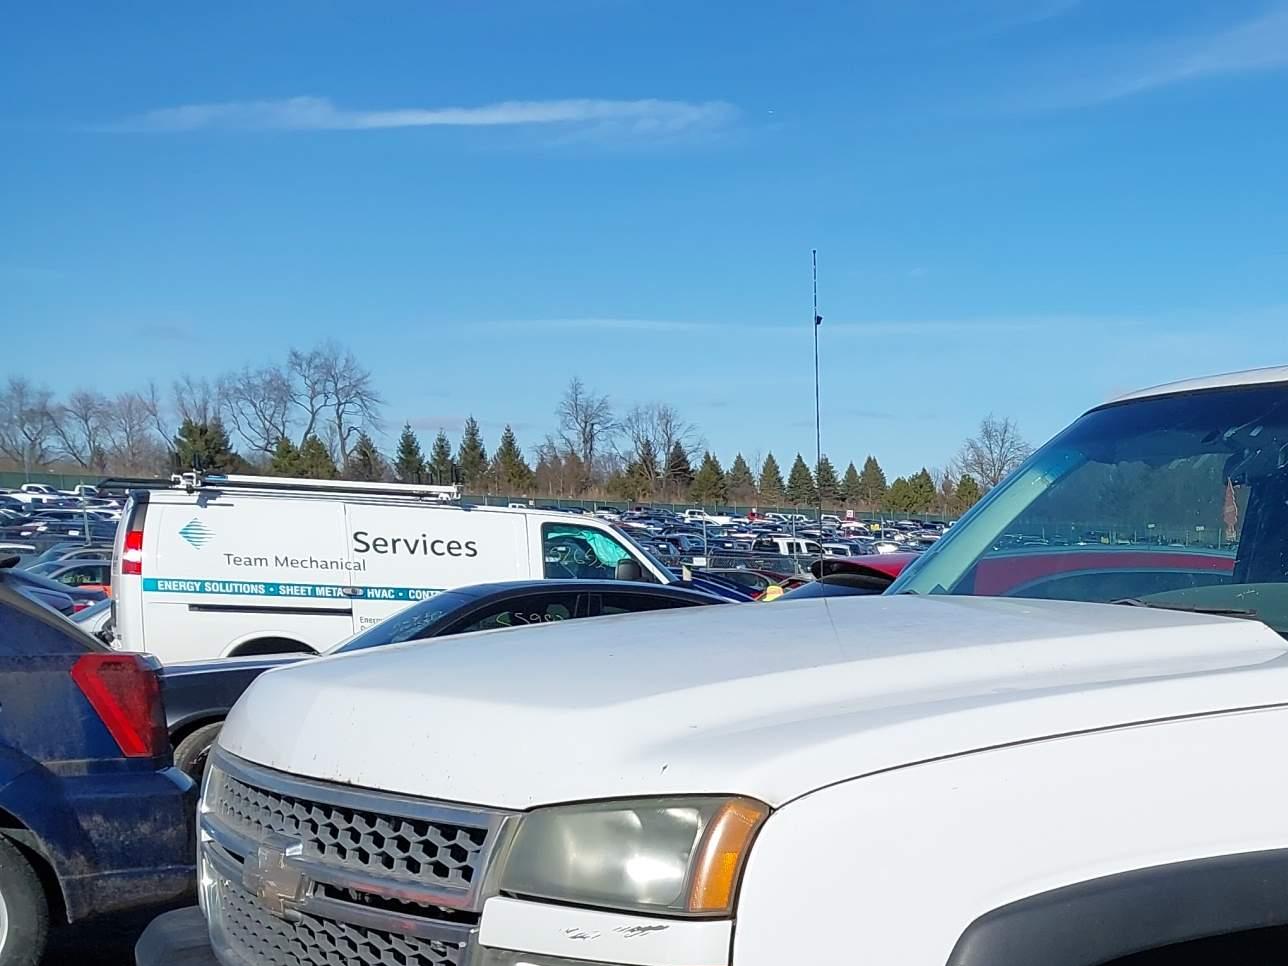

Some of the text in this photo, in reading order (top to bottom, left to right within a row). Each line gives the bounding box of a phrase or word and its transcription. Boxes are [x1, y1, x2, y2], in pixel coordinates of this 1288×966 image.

[352, 531, 478, 557] Services
[223, 553, 367, 571] Team Mechanical
[157, 580, 202, 592] ENERGY
[204, 582, 266, 594] SOLUTIONS
[278, 585, 313, 596] SHEET
[315, 587, 346, 597] META
[366, 588, 396, 599] HVAC
